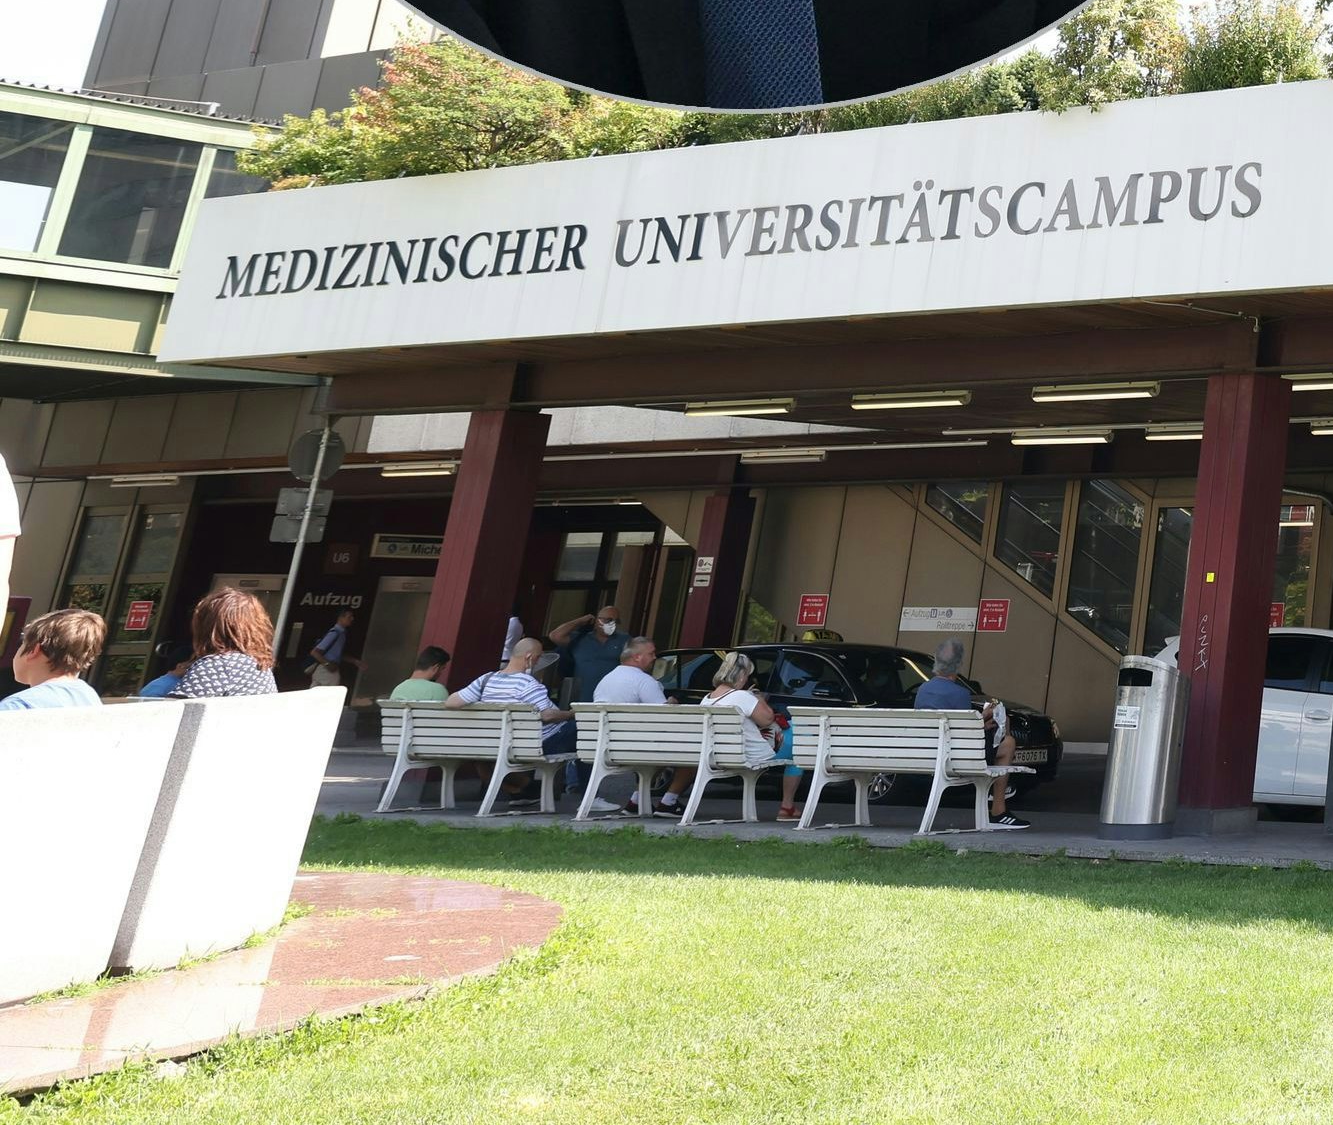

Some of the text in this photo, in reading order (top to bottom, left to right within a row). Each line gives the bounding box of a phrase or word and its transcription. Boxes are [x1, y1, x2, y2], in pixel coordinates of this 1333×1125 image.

[215, 160, 1263, 300] MEDIZINISCHER UNIVERSITÄTSCAMPUS
[300, 591, 363, 609] Aufzug
